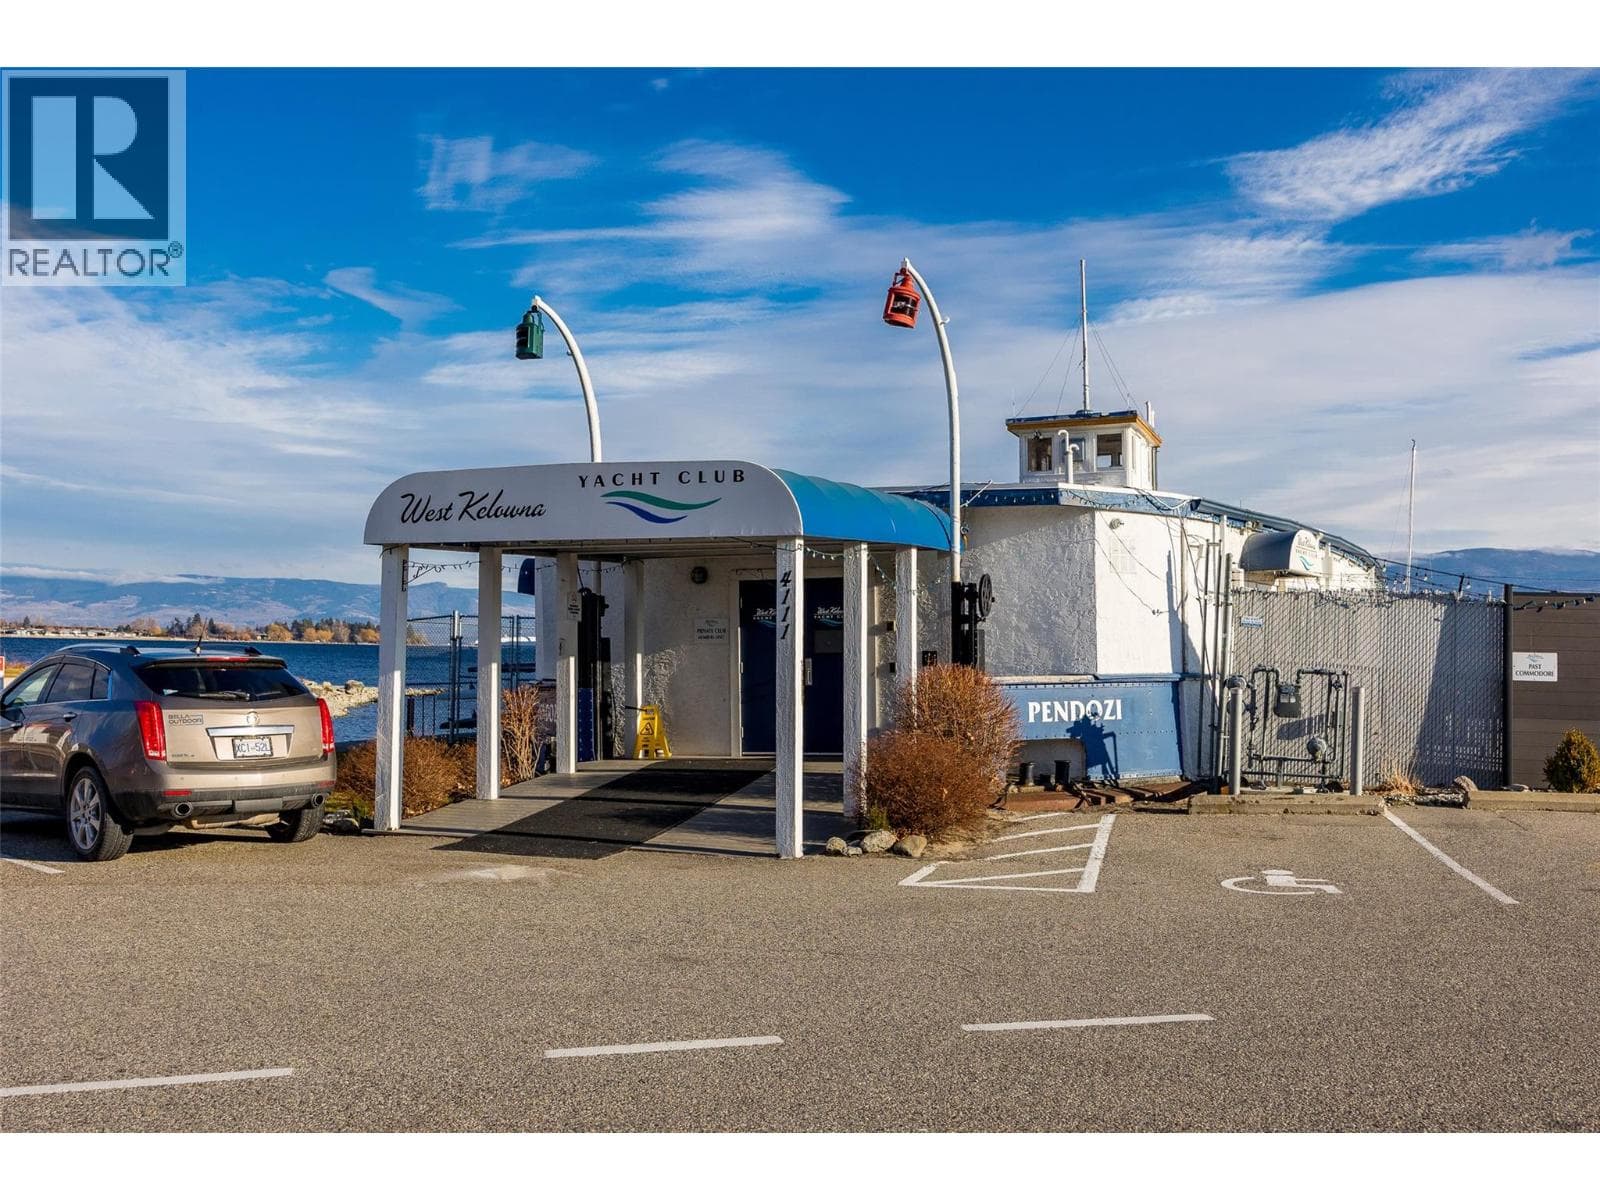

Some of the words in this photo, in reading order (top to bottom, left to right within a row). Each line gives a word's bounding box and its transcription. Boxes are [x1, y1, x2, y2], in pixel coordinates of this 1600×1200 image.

[578, 472, 660, 488] YACHT
[678, 469, 745, 484] CLUB
[400, 493, 453, 524] West
[457, 489, 546, 521] Kelowna
[779, 570, 792, 640] 4111
[1028, 699, 1122, 722] PENDOZI
